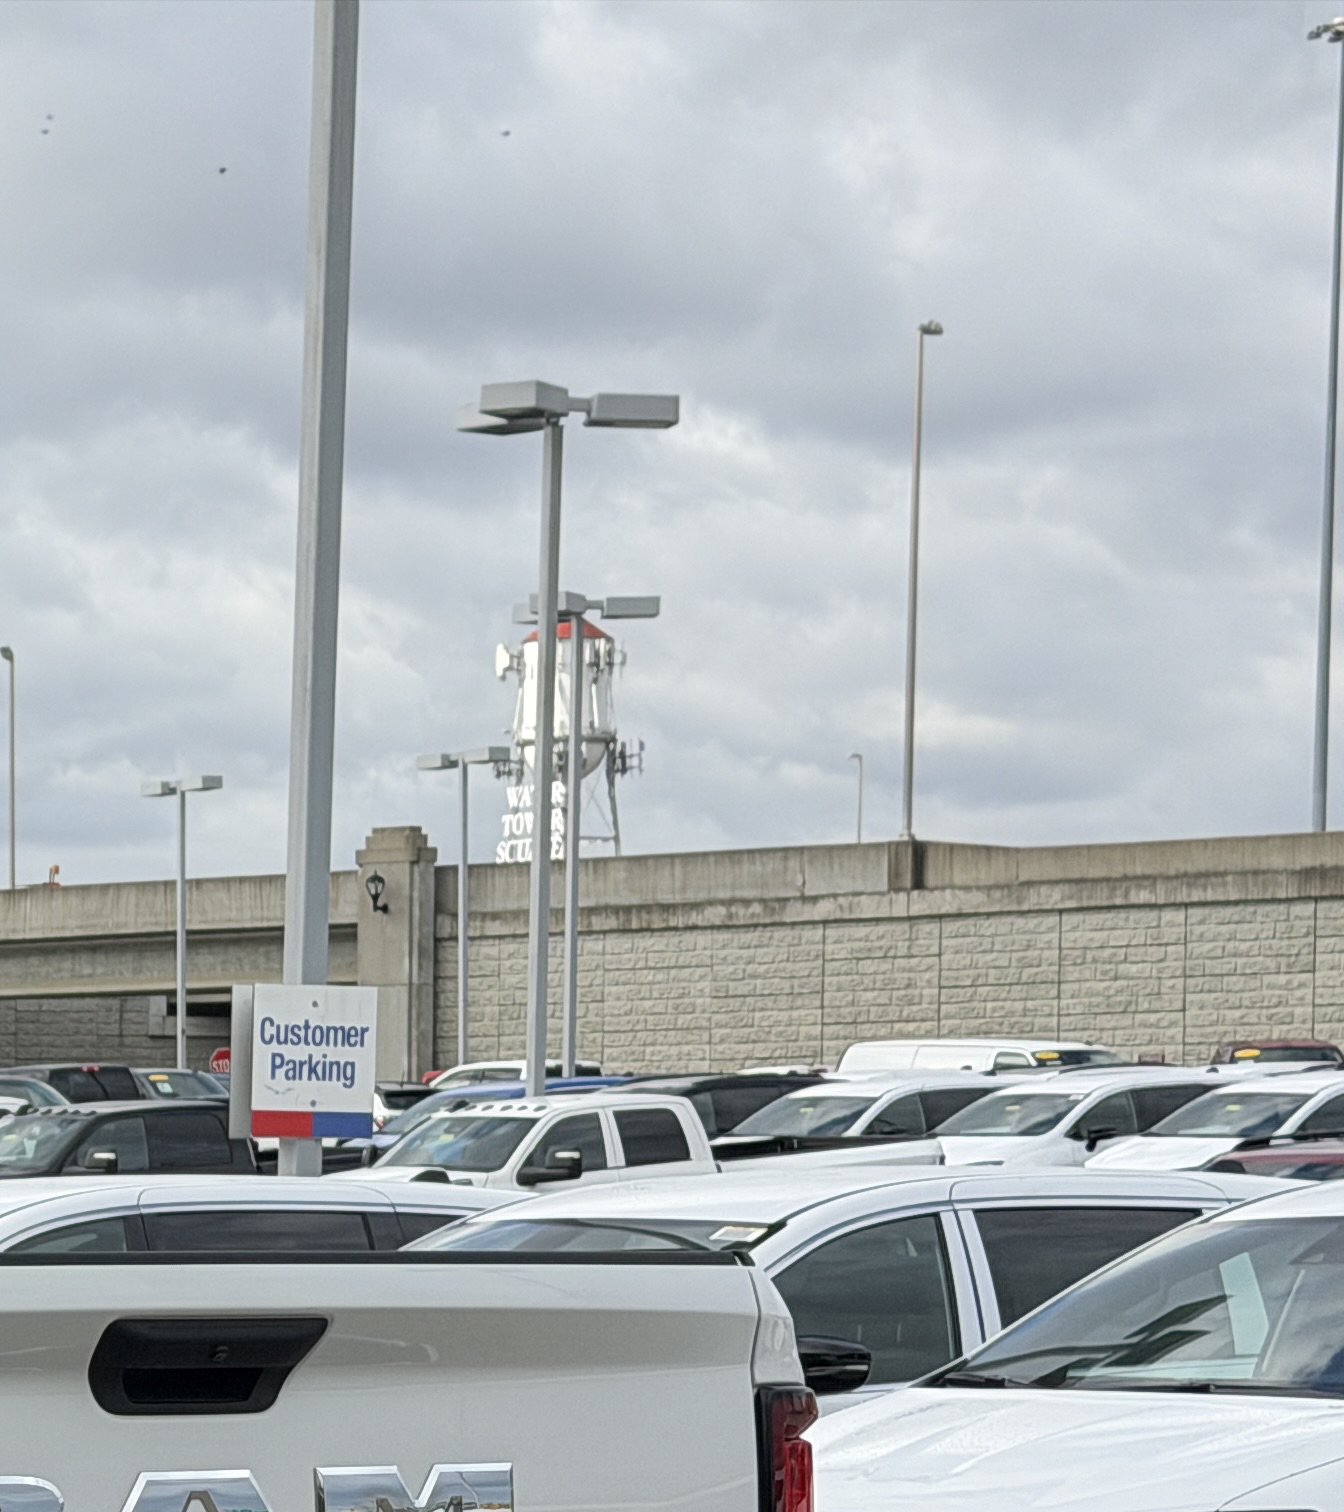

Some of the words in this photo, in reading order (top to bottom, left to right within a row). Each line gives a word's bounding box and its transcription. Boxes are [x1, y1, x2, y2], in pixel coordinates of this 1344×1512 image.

[506, 780, 566, 808] WAR
[501, 808, 565, 838] TOR
[260, 1016, 370, 1048] Customer
[212, 1058, 230, 1073] STO
[270, 1052, 356, 1089] Parking
